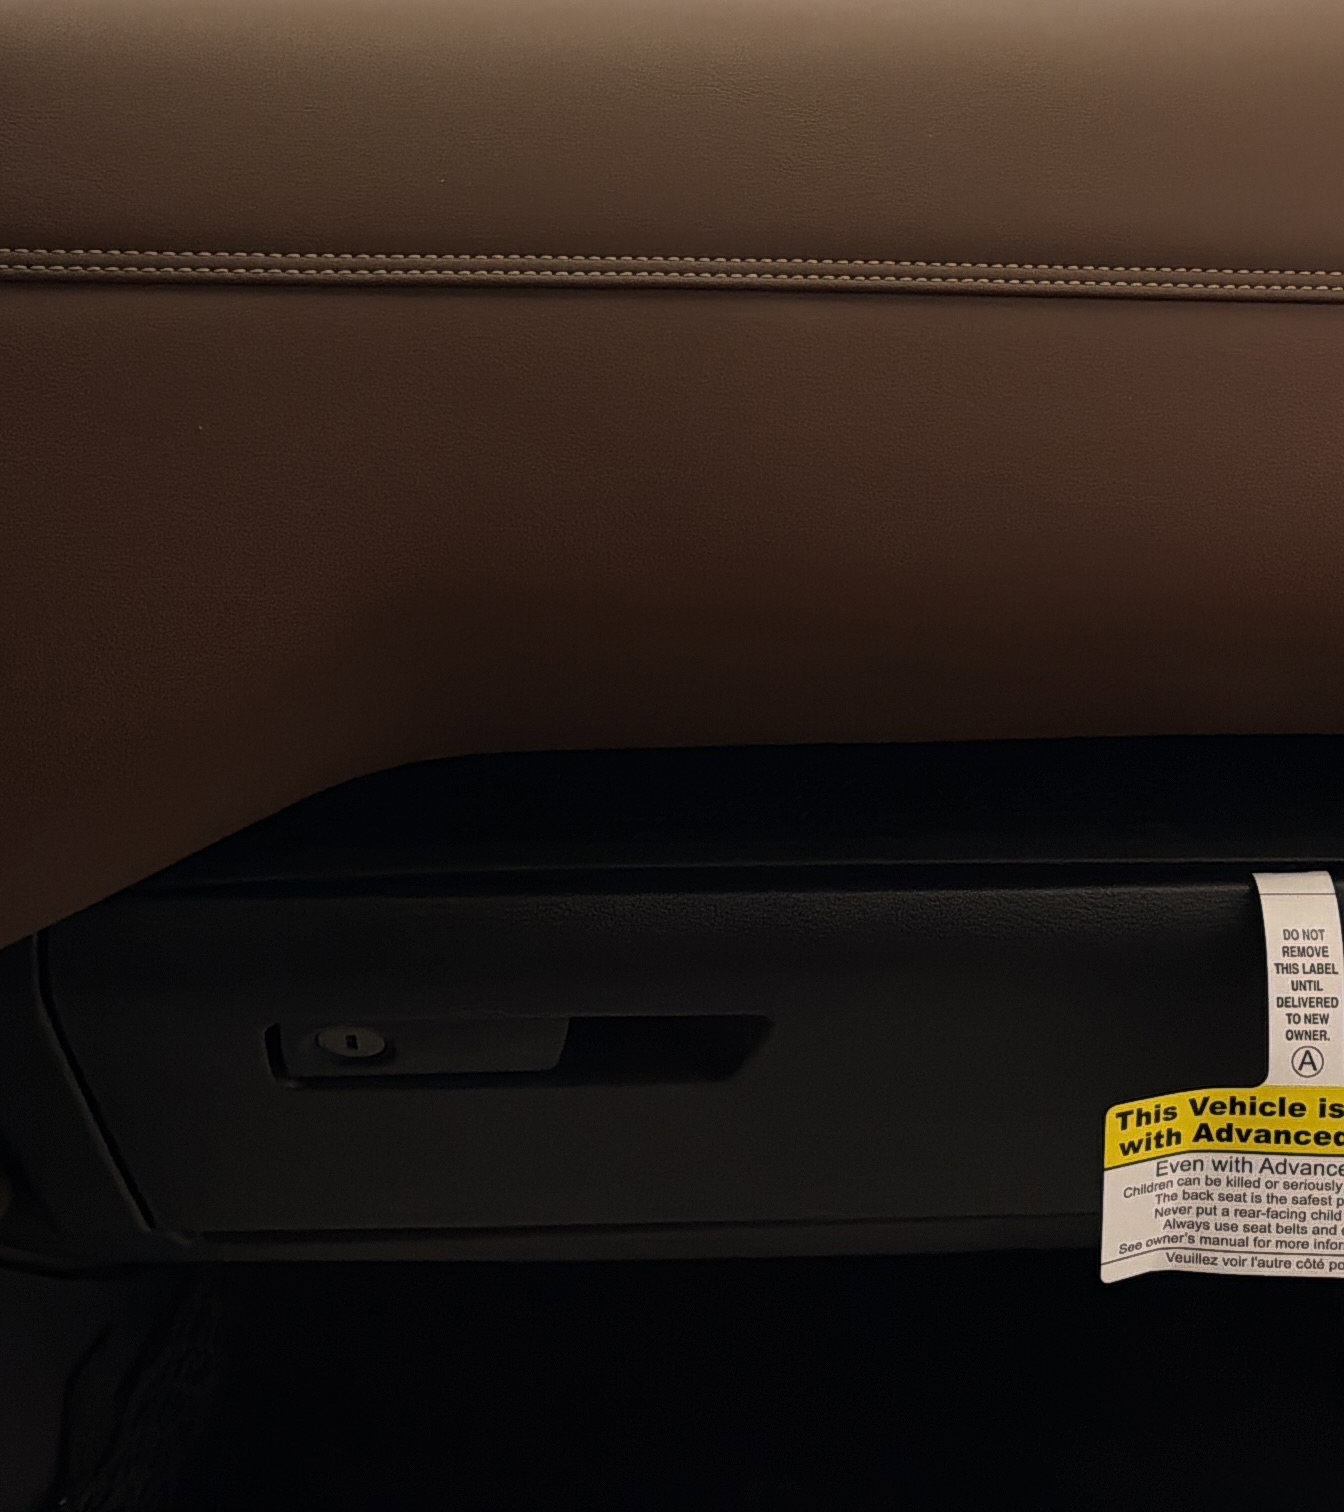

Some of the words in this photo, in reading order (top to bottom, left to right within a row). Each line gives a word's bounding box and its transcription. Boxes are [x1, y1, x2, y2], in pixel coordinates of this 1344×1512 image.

[1282, 929, 1299, 941] DO
[1302, 929, 1325, 941] NOT
[1282, 946, 1329, 958] REMOVE
[1274, 963, 1299, 974] THIS
[1302, 963, 1339, 975] LABEL
[1291, 980, 1323, 991] UNTIL
[1276, 997, 1339, 1008] DELIVERED
[1285, 1013, 1301, 1024] TO
[1304, 1013, 1329, 1025] NEW
[1285, 1029, 1330, 1041] OWNER.
[1116, 1104, 1178, 1131] This
[1189, 1095, 1306, 1117] Vehicle
[1318, 1098, 1344, 1119] is
[1119, 1127, 1182, 1156] with
[1156, 1159, 1204, 1177] Even
[1211, 1156, 1253, 1174] with
[1123, 1179, 1174, 1199] Children
[1177, 1177, 1201, 1187] can
[1205, 1175, 1222, 1187] be
[1226, 1175, 1261, 1189] killed
[1265, 1179, 1280, 1189] or
[1282, 1177, 1343, 1194] seriously
[1155, 1192, 1178, 1205] The
[1182, 1190, 1214, 1202] back
[1217, 1192, 1248, 1204] seat
[1251, 1192, 1263, 1204] is
[1266, 1192, 1288, 1205] the
[1291, 1194, 1333, 1207] safest
[1154, 1205, 1192, 1219] Never
[1196, 1205, 1217, 1218] put
[1221, 1207, 1230, 1217] a
[1233, 1207, 1307, 1223] rear-facing
[1311, 1210, 1342, 1222] child
[1162, 1218, 1210, 1233] Always
[1214, 1221, 1239, 1232] use
[1242, 1221, 1272, 1234] seat
[1275, 1222, 1308, 1235] belts
[1312, 1225, 1337, 1236] and
[1119, 1241, 1143, 1255] See
[1146, 1233, 1196, 1247] owner's
[1199, 1234, 1249, 1247] manual
[1253, 1235, 1271, 1248] for
[1275, 1238, 1309, 1250] more
[1166, 1252, 1219, 1266] Veuillez
[1222, 1254, 1247, 1267] voir
[1251, 1255, 1292, 1269] l'autre
[1295, 1257, 1325, 1270] côté
